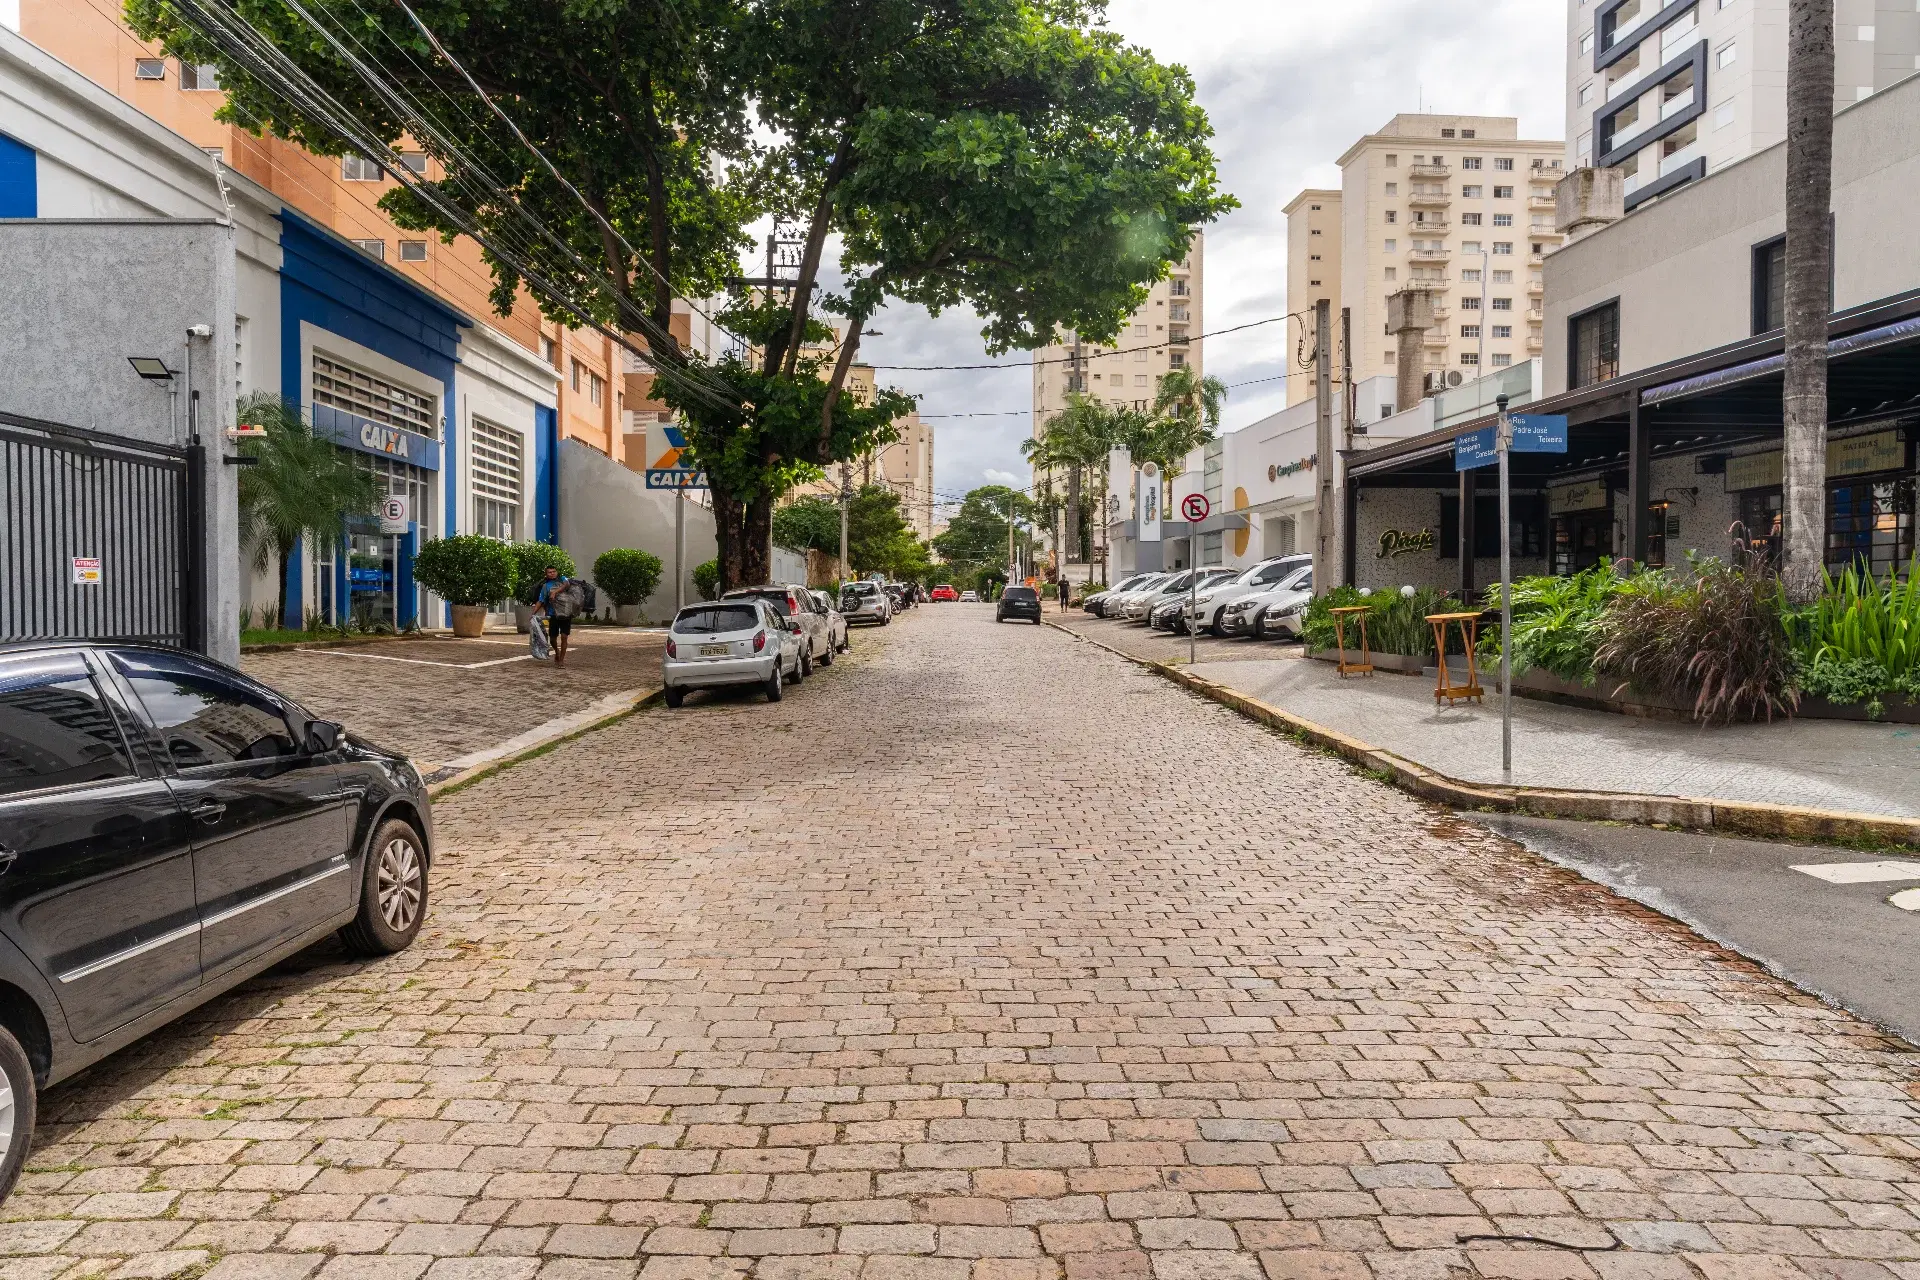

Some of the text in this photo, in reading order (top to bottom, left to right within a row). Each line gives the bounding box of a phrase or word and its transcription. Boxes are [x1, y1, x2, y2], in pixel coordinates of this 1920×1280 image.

[1512, 416, 1526, 424] Rua
[1512, 426, 1548, 434] Padre José
[361, 423, 409, 458] CAIXA
[1458, 435, 1478, 445] Avenida
[1538, 435, 1563, 443] Teixeira
[1458, 443, 1481, 454] Benjamin
[650, 472, 709, 486] CAIXA
[390, 503, 398, 516] E
